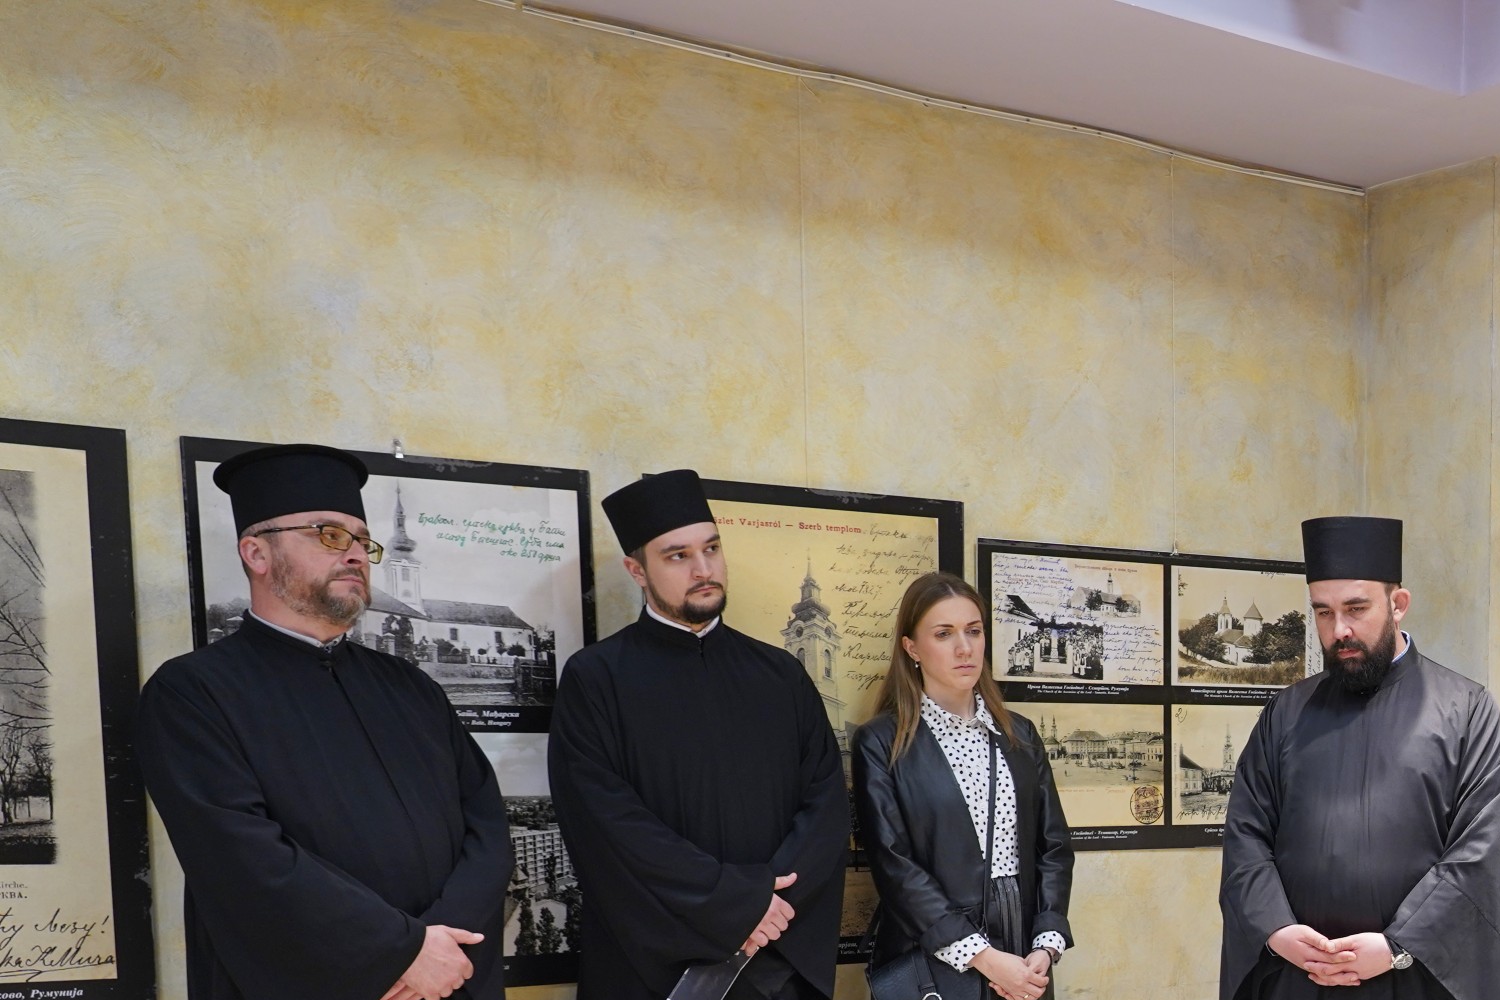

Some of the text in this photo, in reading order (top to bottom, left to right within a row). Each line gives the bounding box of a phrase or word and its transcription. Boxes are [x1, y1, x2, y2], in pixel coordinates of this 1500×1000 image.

[739, 518, 781, 528] Varjasról
[798, 522, 822, 530] Szerb
[826, 525, 862, 534] templom
[482, 710, 520, 719] Мађарска
[30, 988, 83, 1000] Румунија
